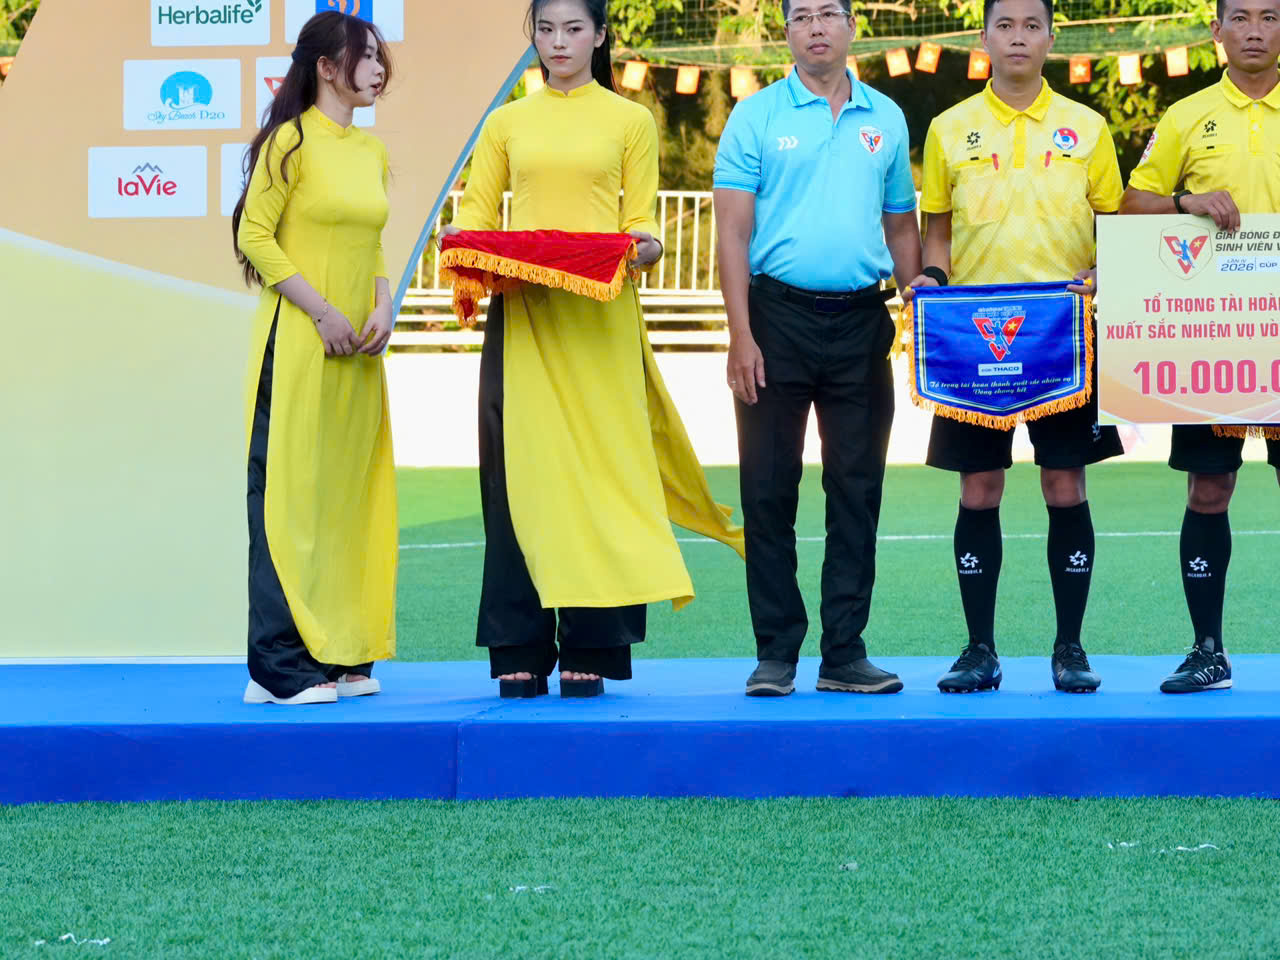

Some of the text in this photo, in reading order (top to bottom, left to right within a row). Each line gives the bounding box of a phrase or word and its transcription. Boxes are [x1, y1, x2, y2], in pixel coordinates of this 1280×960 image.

[158, 4, 254, 24] Herbalife
[199, 111, 225, 120] D20
[117, 174, 177, 196] laVie
[1215, 243, 1243, 252] SINH
[1247, 242, 1273, 251] VIÊN
[1221, 263, 1254, 271] 2026
[1144, 293, 1162, 313] TỔ
[1166, 298, 1215, 315] TRỌNG
[1220, 293, 1243, 312] TÀI
[1106, 321, 1143, 339] XUẤT
[1148, 318, 1176, 339] SẮC
[1181, 321, 1231, 340] NHIỆM
[1236, 323, 1255, 340] VỤ
